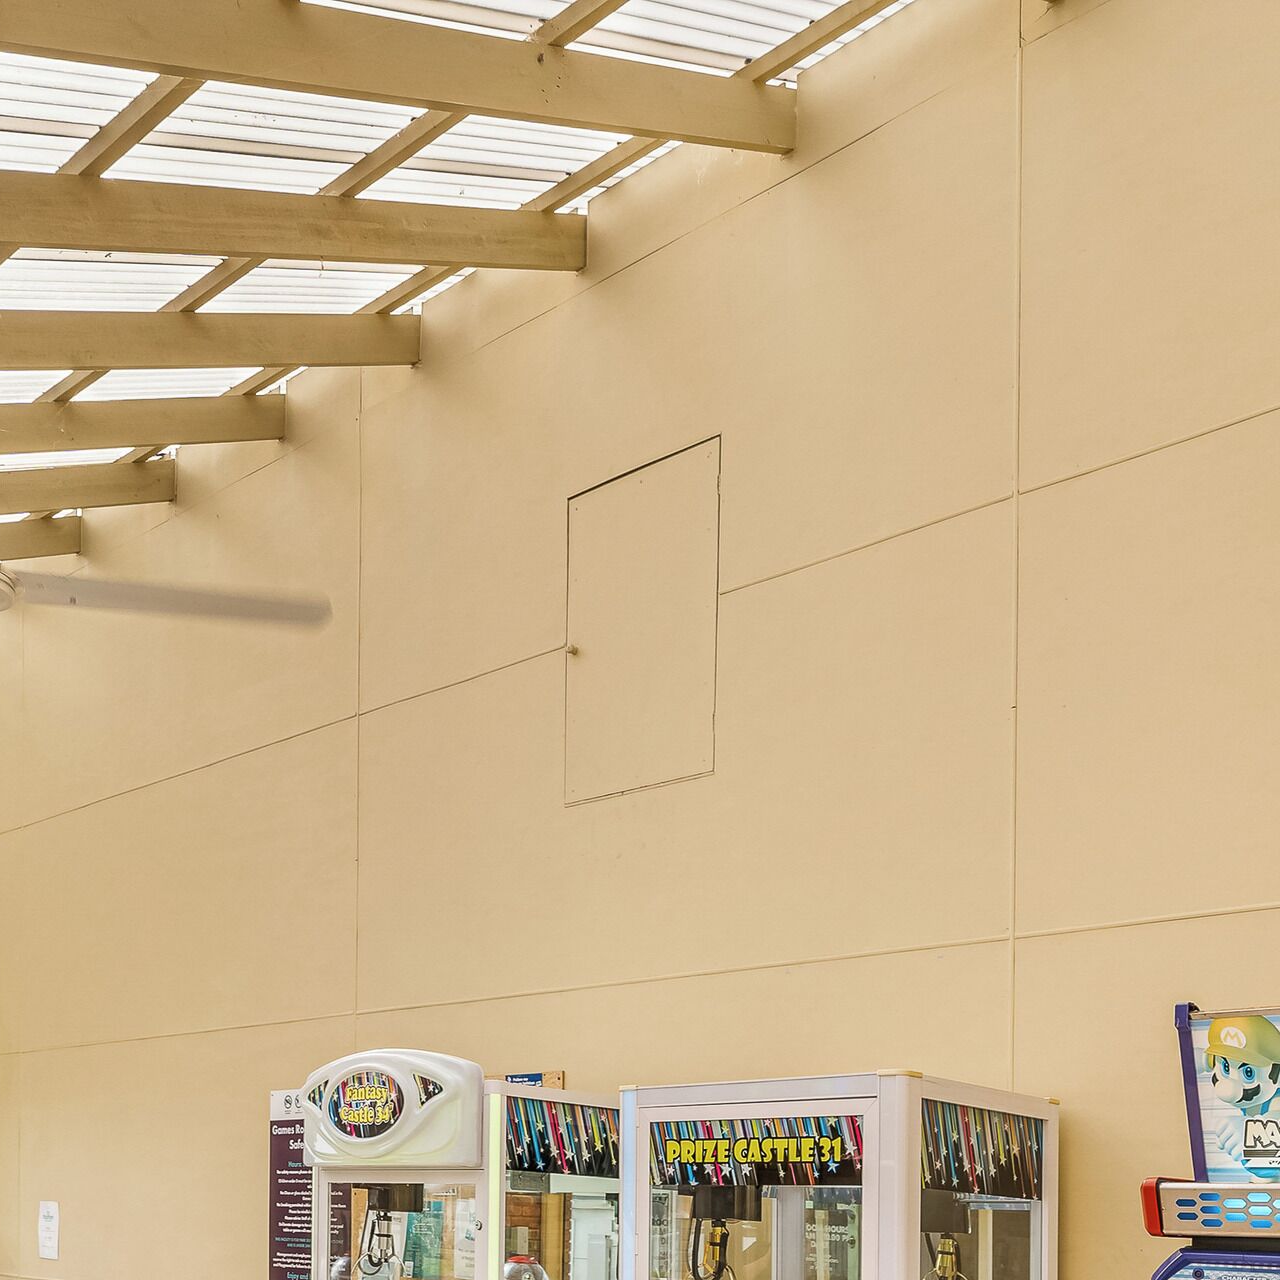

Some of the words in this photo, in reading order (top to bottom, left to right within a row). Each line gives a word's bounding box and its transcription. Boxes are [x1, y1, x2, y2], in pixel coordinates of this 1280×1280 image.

[345, 1085, 388, 1104] Fantasy
[340, 1106, 373, 1123] Castle
[272, 1125, 294, 1135] Games
[289, 1139, 304, 1150] Safe
[666, 1138, 730, 1164] PRIZE
[733, 1136, 816, 1164] CASTLE
[819, 1136, 842, 1163] 31
